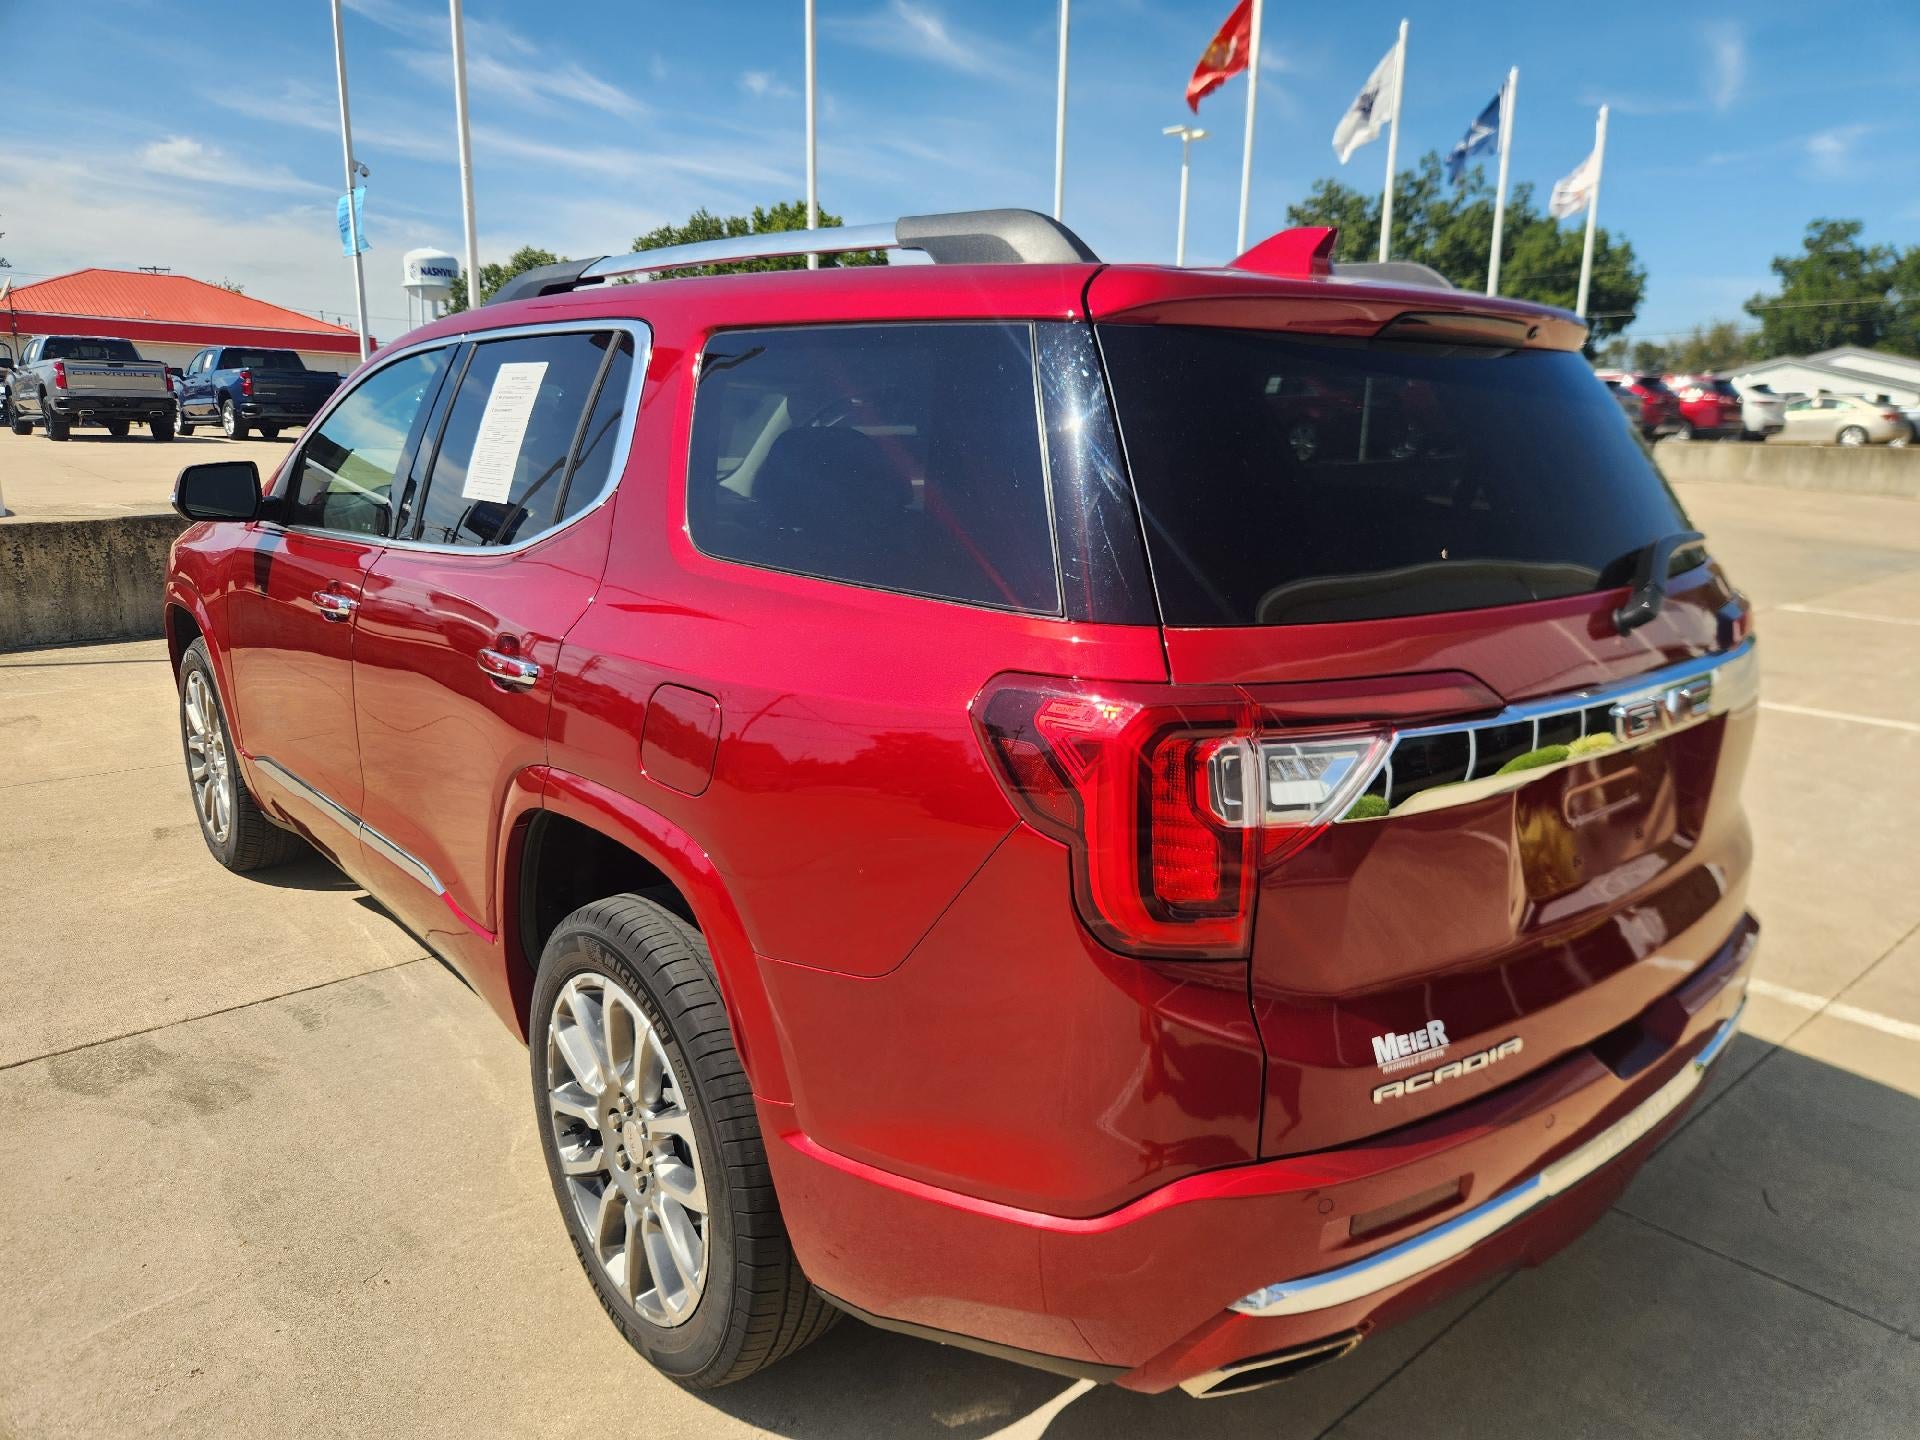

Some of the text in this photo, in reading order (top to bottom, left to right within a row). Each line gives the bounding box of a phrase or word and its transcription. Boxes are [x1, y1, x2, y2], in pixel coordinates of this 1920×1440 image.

[73, 370, 157, 378] CHEVROLET
[1608, 677, 1712, 740] GMC
[604, 954, 671, 1041] MICHELIN
[1371, 1019, 1450, 1065] MEIER
[1372, 1036, 1524, 1104] ACADIA
